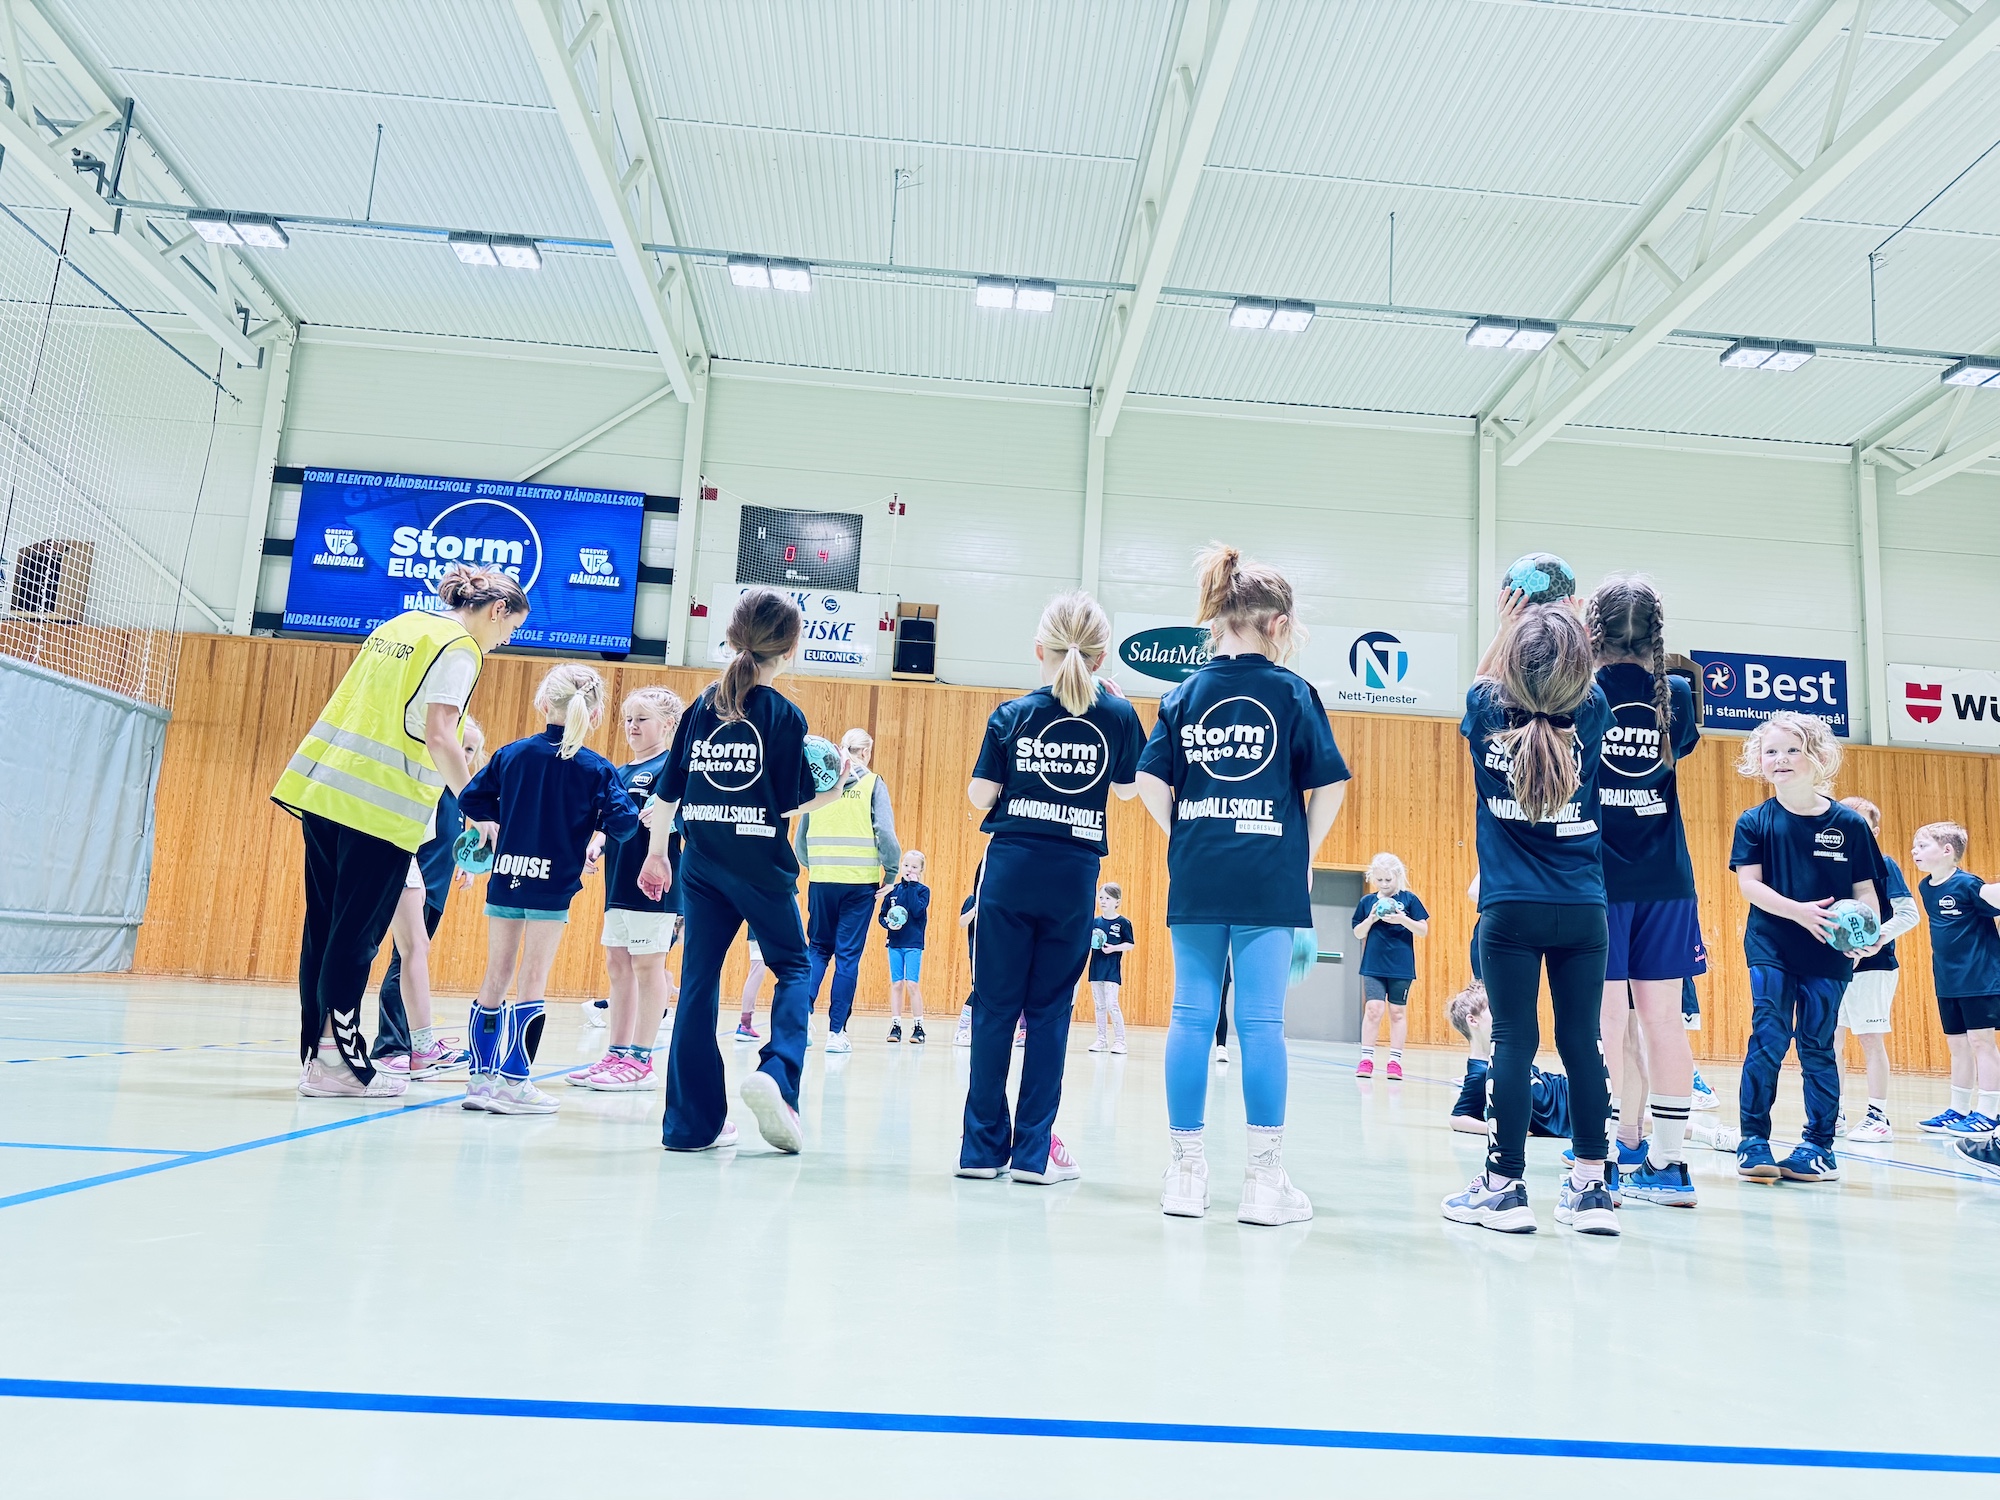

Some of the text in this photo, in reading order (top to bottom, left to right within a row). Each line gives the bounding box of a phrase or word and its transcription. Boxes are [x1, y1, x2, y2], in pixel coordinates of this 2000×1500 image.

[336, 472, 383, 487] ELEKTRO
[384, 473, 472, 494] HÅNDBALLSKOLE
[475, 483, 515, 497] STORM
[516, 486, 562, 501] ELEKTRO
[757, 526, 767, 540] H
[389, 526, 524, 564] Storm
[313, 551, 364, 567] HÅNDBALL
[387, 557, 450, 580] Elek
[568, 571, 620, 587] HÅNDBALL
[365, 618, 388, 630] STO
[548, 631, 587, 645] STORM
[805, 650, 861, 663] EURONICS
[1128, 641, 1214, 666] SalatMes
[1745, 663, 1837, 705] Best
[1338, 690, 1417, 704] Nett-Tjenester
[1716, 706, 1779, 720] stamkund
[1820, 713, 1845, 725] gså!
[1180, 724, 1265, 747] Storm
[1605, 726, 1660, 745] orm
[691, 740, 757, 760] Storm
[1016, 737, 1097, 761] Storm
[1235, 744, 1263, 760] AS
[1601, 741, 1659, 759] ktro AS
[689, 759, 756, 773] Elektro AS
[809, 762, 834, 785] SELECT
[1016, 758, 1096, 775] Elektro AS
[1599, 787, 1663, 807] DBALLSKOLE
[682, 803, 767, 824] HÅNDBALLSKOLE
[1007, 798, 1104, 829] HÅNDBALLSKOLE
[493, 853, 551, 879] LOUISE
[1848, 916, 1865, 944] SELECT
